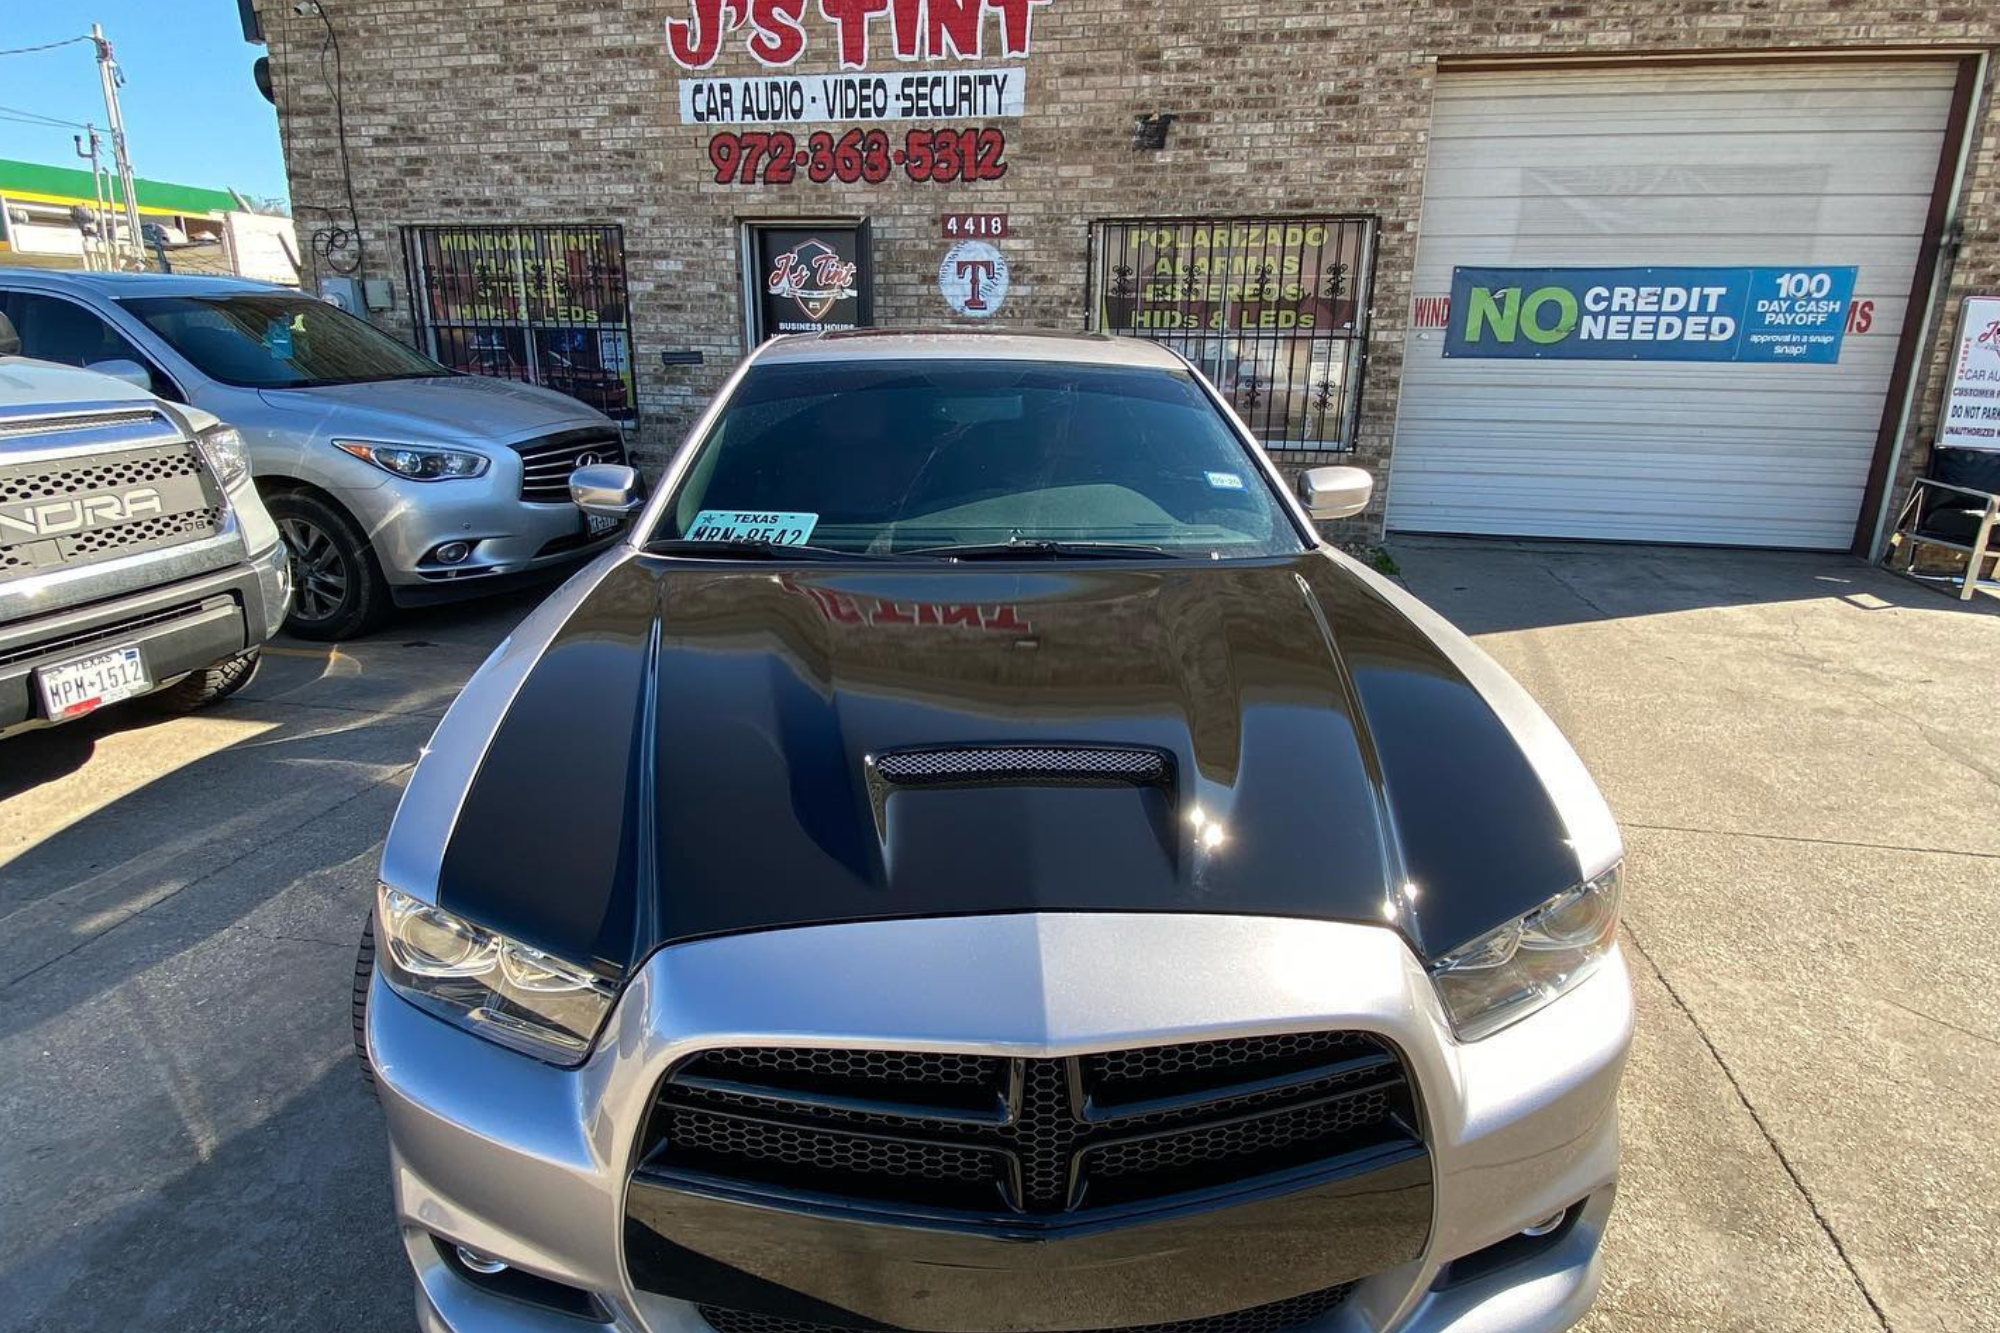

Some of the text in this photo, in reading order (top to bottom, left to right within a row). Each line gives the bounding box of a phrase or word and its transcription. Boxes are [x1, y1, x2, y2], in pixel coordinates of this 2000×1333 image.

[666, 0, 1052, 70] J'S TINT
[692, 73, 1008, 122] CAR AUDIO VIDEO SECURITY
[947, 216, 1002, 235] 4418
[1130, 227, 1329, 249] POLARIZADO
[812, 253, 857, 288] Tint
[1155, 255, 1301, 276] ALARMAS
[1145, 283, 1306, 303] ESTEREOS
[1775, 272, 1832, 299] 100
[1583, 286, 1728, 313] CREDIT
[1756, 300, 1841, 313] DAY CASH
[543, 305, 600, 322] LEDs
[1130, 309, 1199, 328] HIDs
[1241, 309, 1316, 328] LEDs
[1414, 297, 1451, 328] WIND
[1464, 286, 1578, 344] NO
[1764, 312, 1829, 326] PAYOFF
[779, 322, 822, 331] BUSINESS
[1579, 314, 1736, 341] NEEDED
[1750, 334, 1791, 344] approval
[1792, 333, 1801, 343] in
[1965, 368, 1986, 381] CAR
[1952, 387, 1995, 399] CUSTOMER
[1951, 404, 1963, 418] DO
[1963, 405, 1981, 419] NOT
[1945, 426, 1995, 438] UNAUTHORIZED
[733, 514, 780, 524] TEXAS
[75, 653, 114, 673] TEXAS
